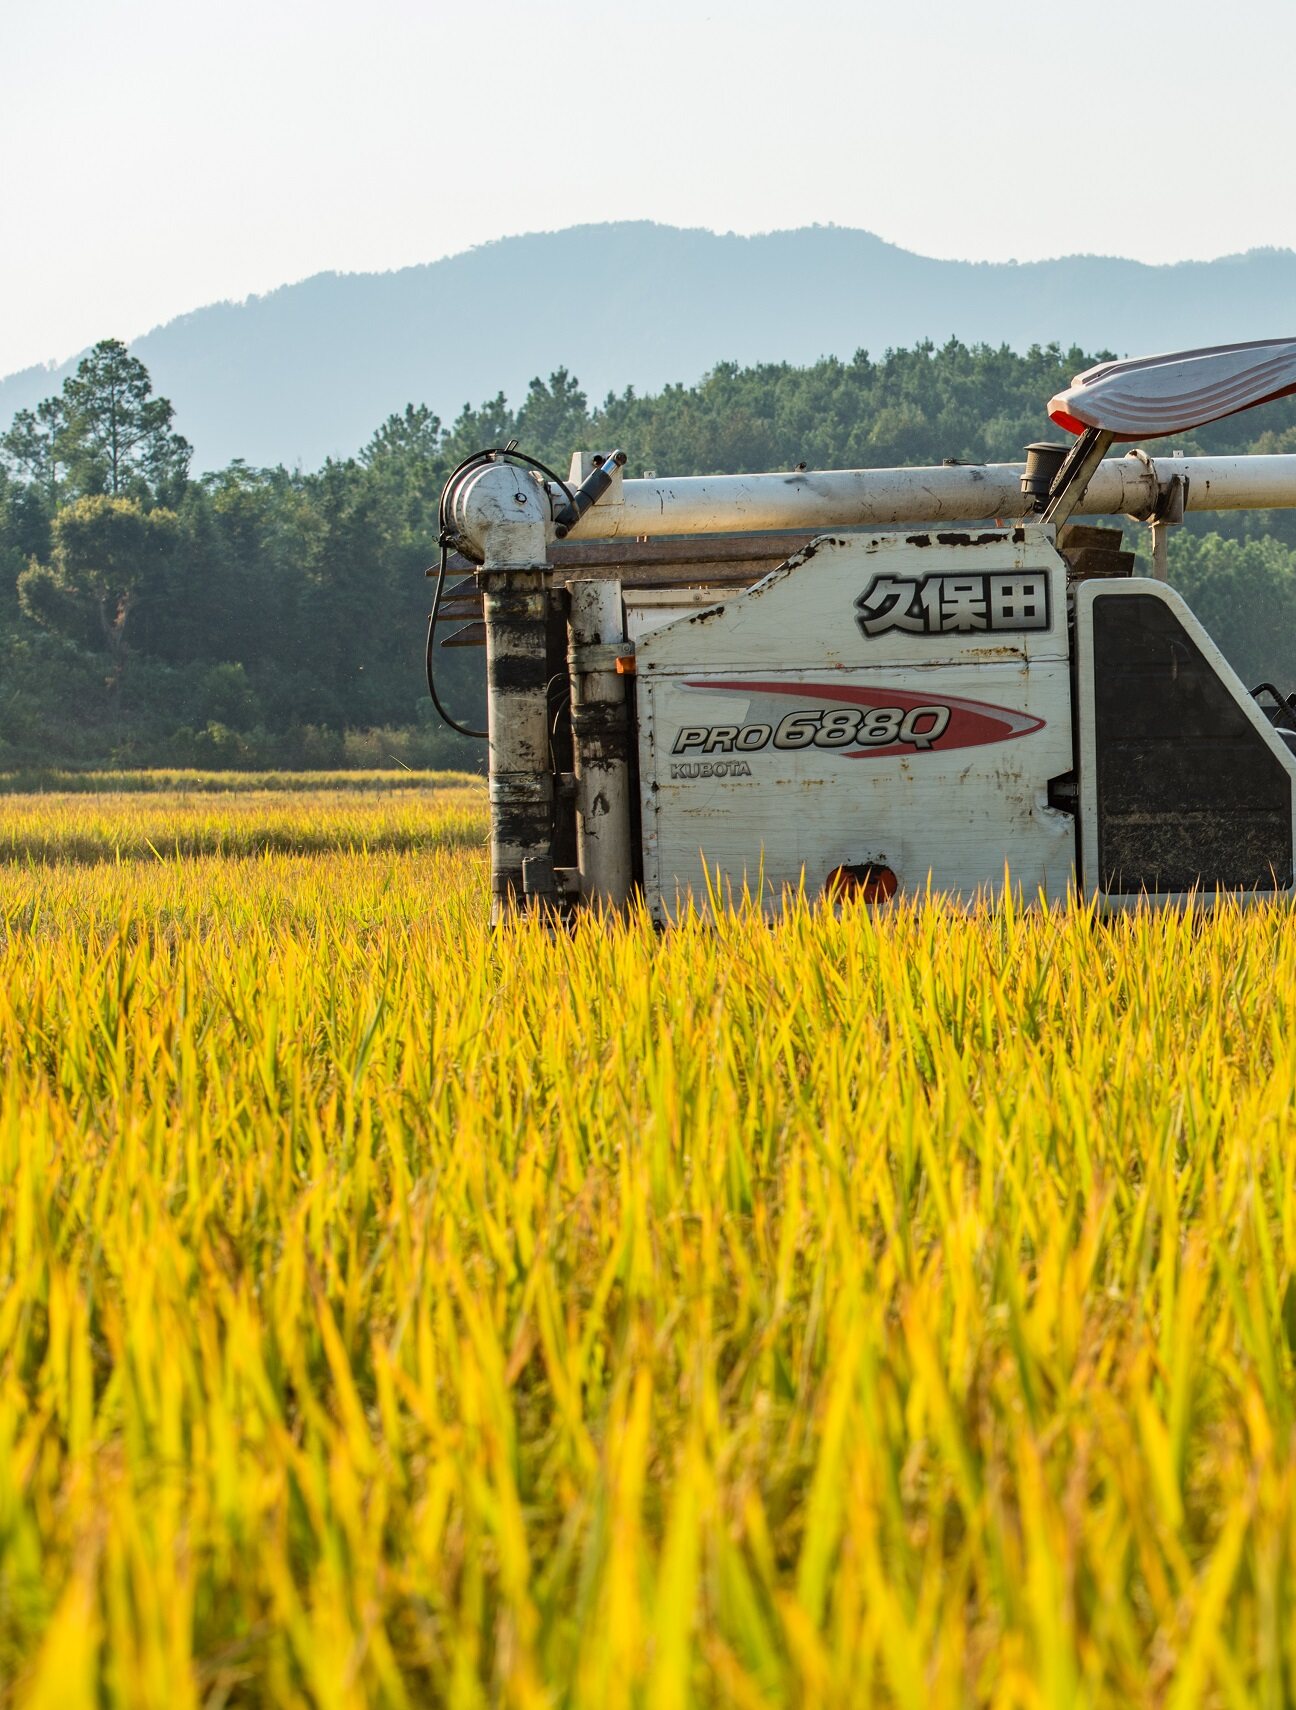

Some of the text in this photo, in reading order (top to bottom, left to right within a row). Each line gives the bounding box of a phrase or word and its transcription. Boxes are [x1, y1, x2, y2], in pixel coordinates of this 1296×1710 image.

[860, 571, 1049, 635] 久保田
[670, 760, 752, 779] KUBOTA
